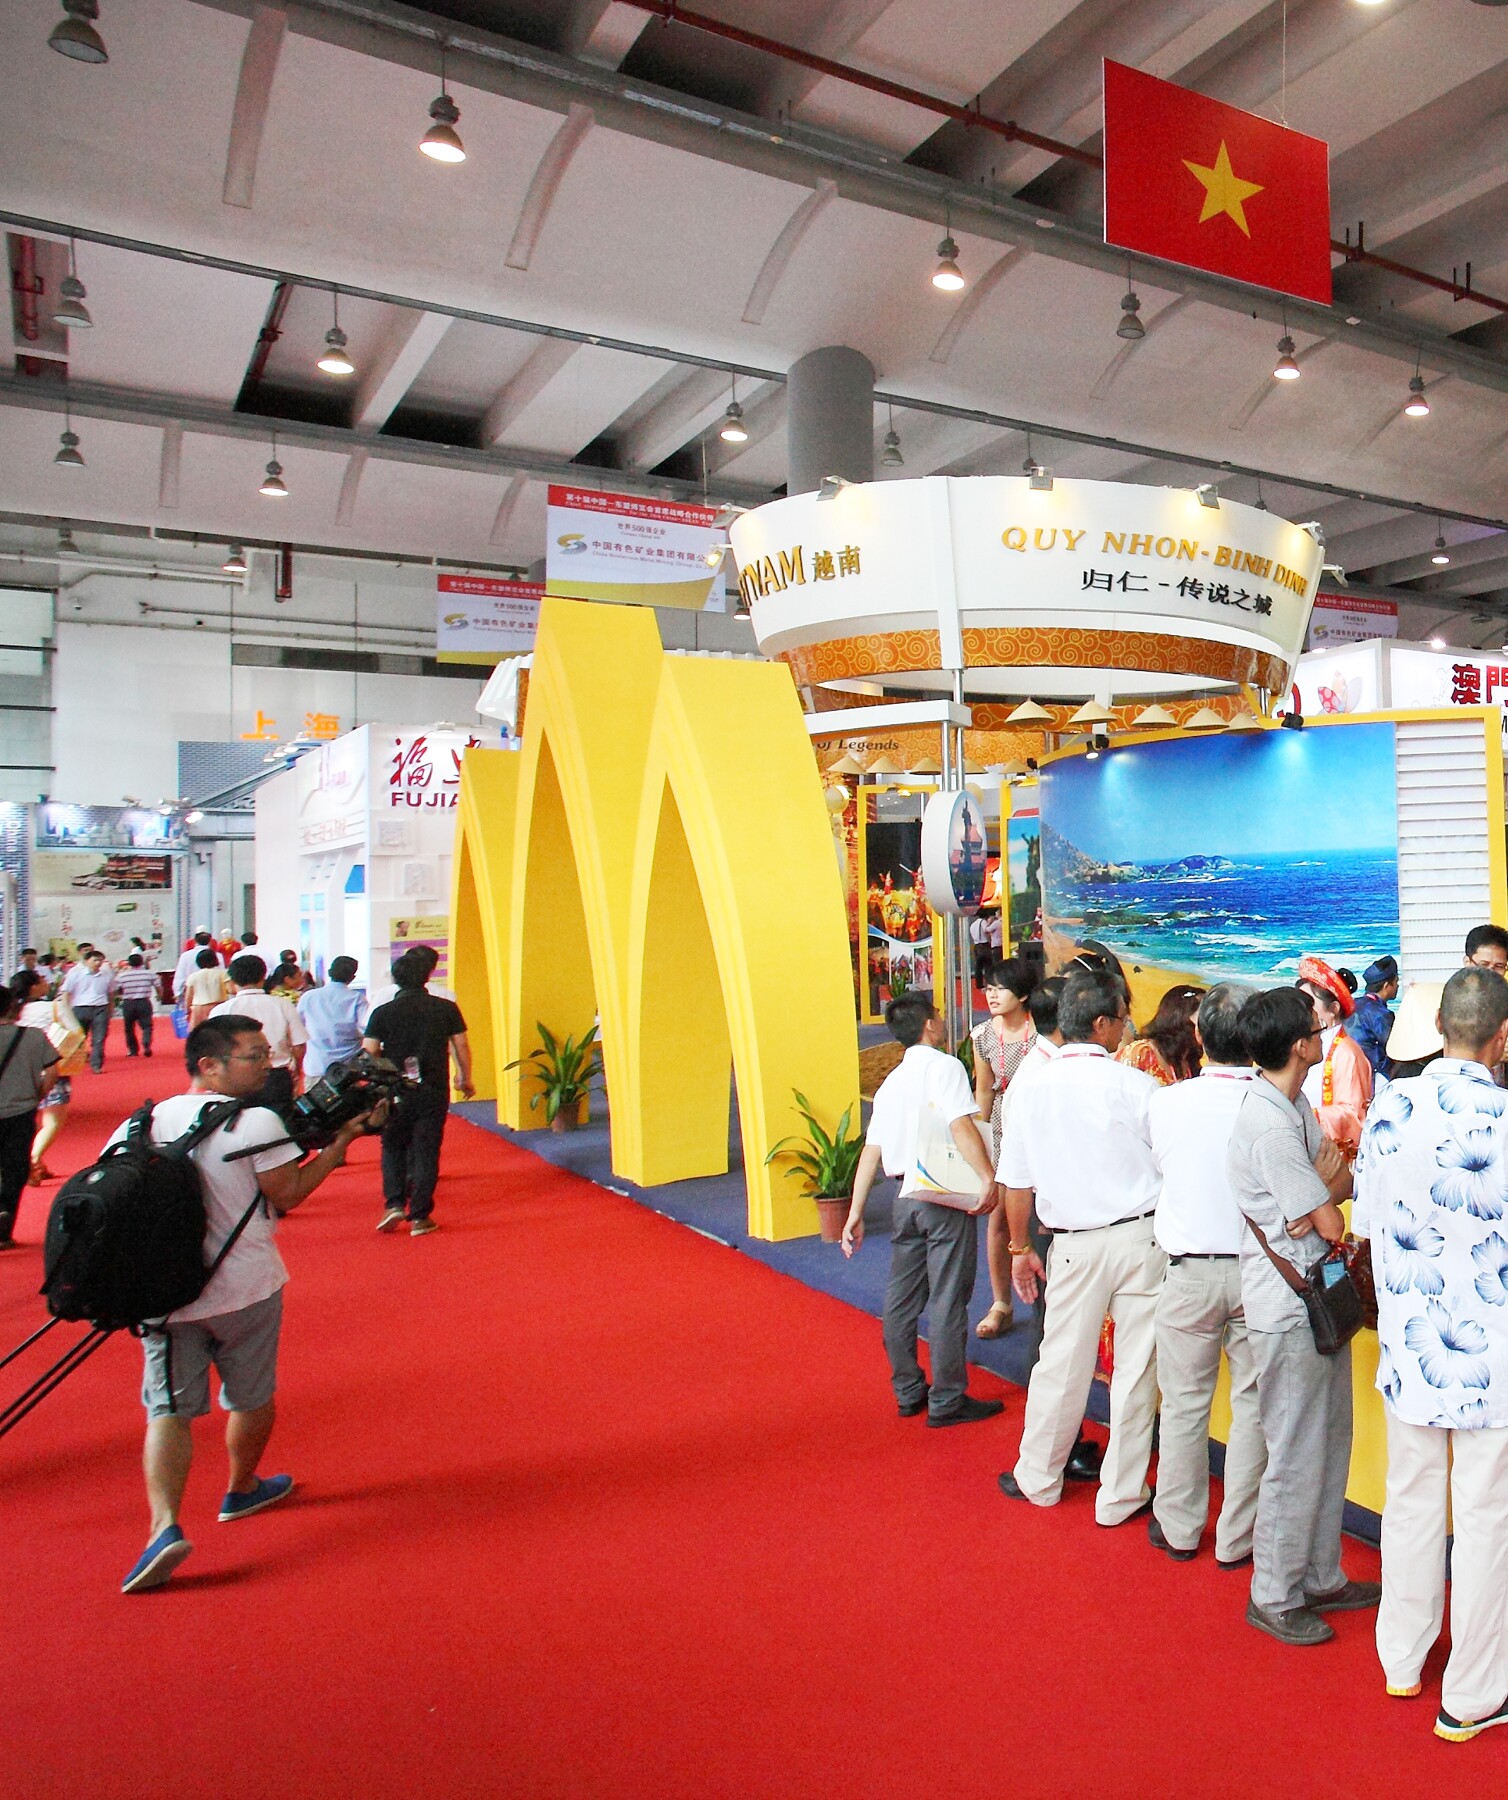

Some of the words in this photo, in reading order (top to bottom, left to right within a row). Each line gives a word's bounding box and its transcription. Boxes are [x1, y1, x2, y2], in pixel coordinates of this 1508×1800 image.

[811, 545, 861, 582] 越南
[1001, 526, 1086, 552] QUY
[1274, 563, 1309, 597] DINH
[240, 710, 340, 739] 上海
[838, 739, 900, 752] Legends
